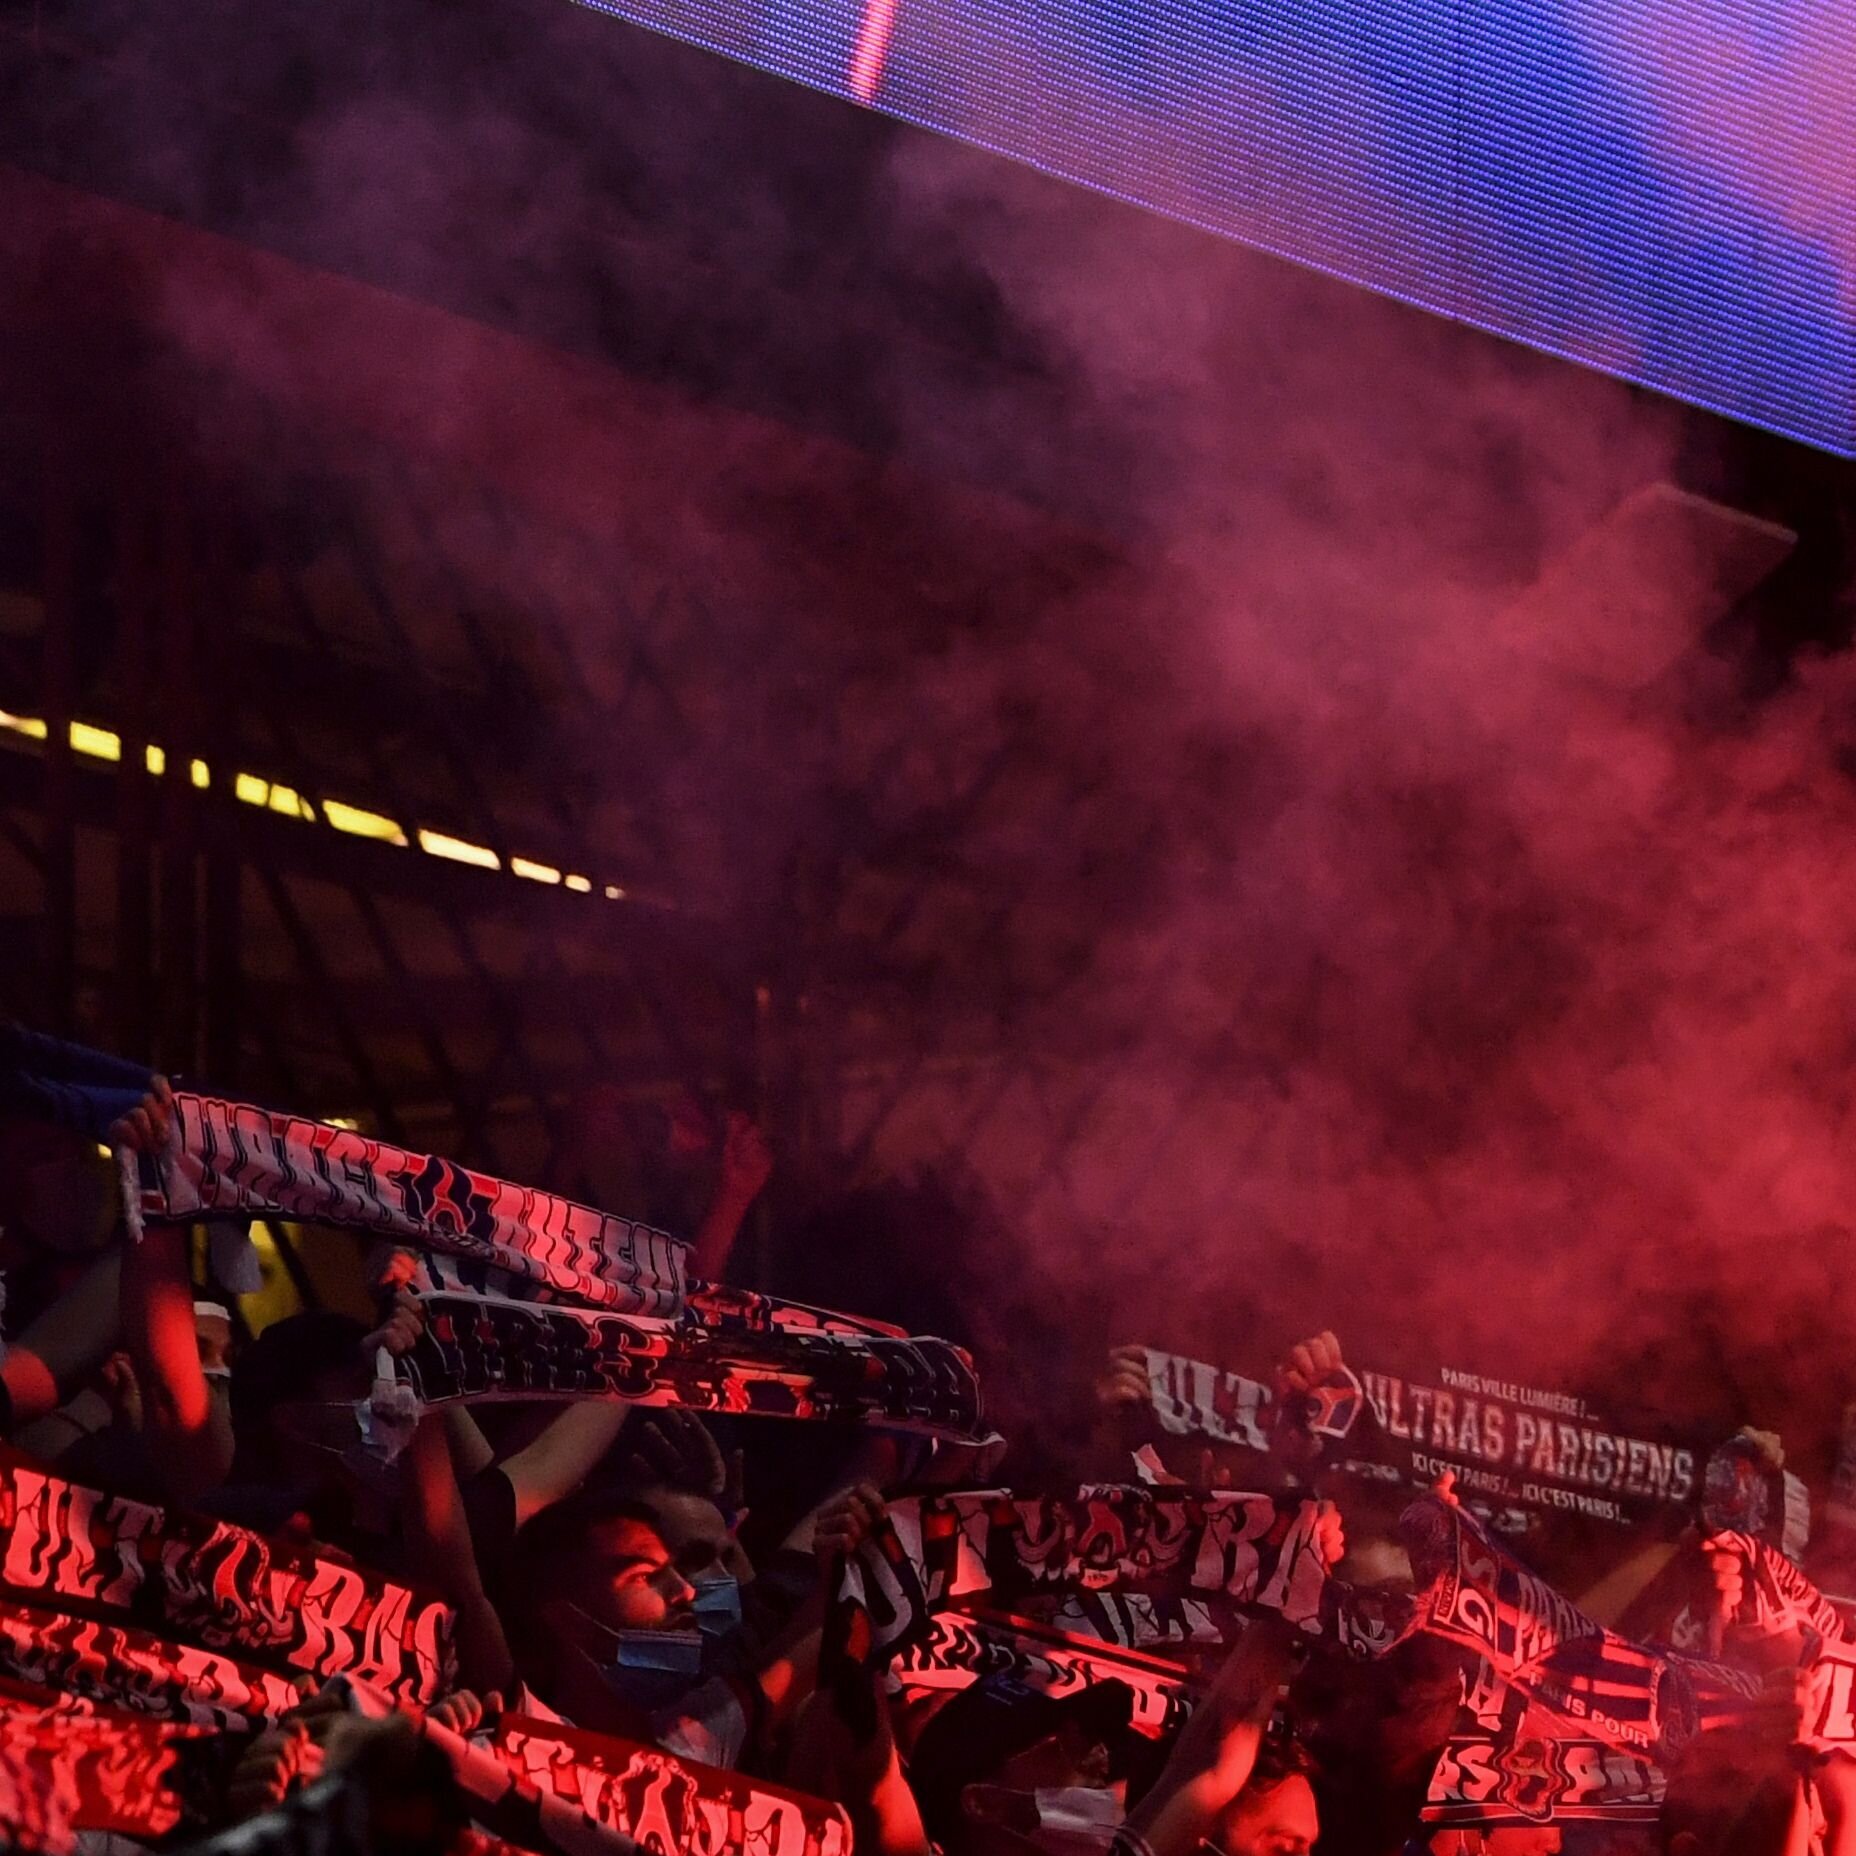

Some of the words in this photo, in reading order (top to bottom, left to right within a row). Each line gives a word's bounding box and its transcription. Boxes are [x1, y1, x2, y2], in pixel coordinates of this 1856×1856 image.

[1441, 1367, 1480, 1393] PARIS
[1480, 1377, 1518, 1402] VILLE
[1518, 1384, 1579, 1415] LUMIÈRE
[1364, 1371, 1504, 1463] ULTRAS
[1514, 1411, 1695, 1502] PARISIENS
[1411, 1451, 1430, 1472] ICI
[1464, 1466, 1500, 1491] PARIS
[1521, 1483, 1541, 1504] ICI
[1541, 1489, 1579, 1512] C'EST
[1579, 1496, 1616, 1520] PARIS
[1590, 1707, 1650, 1750] POUR
